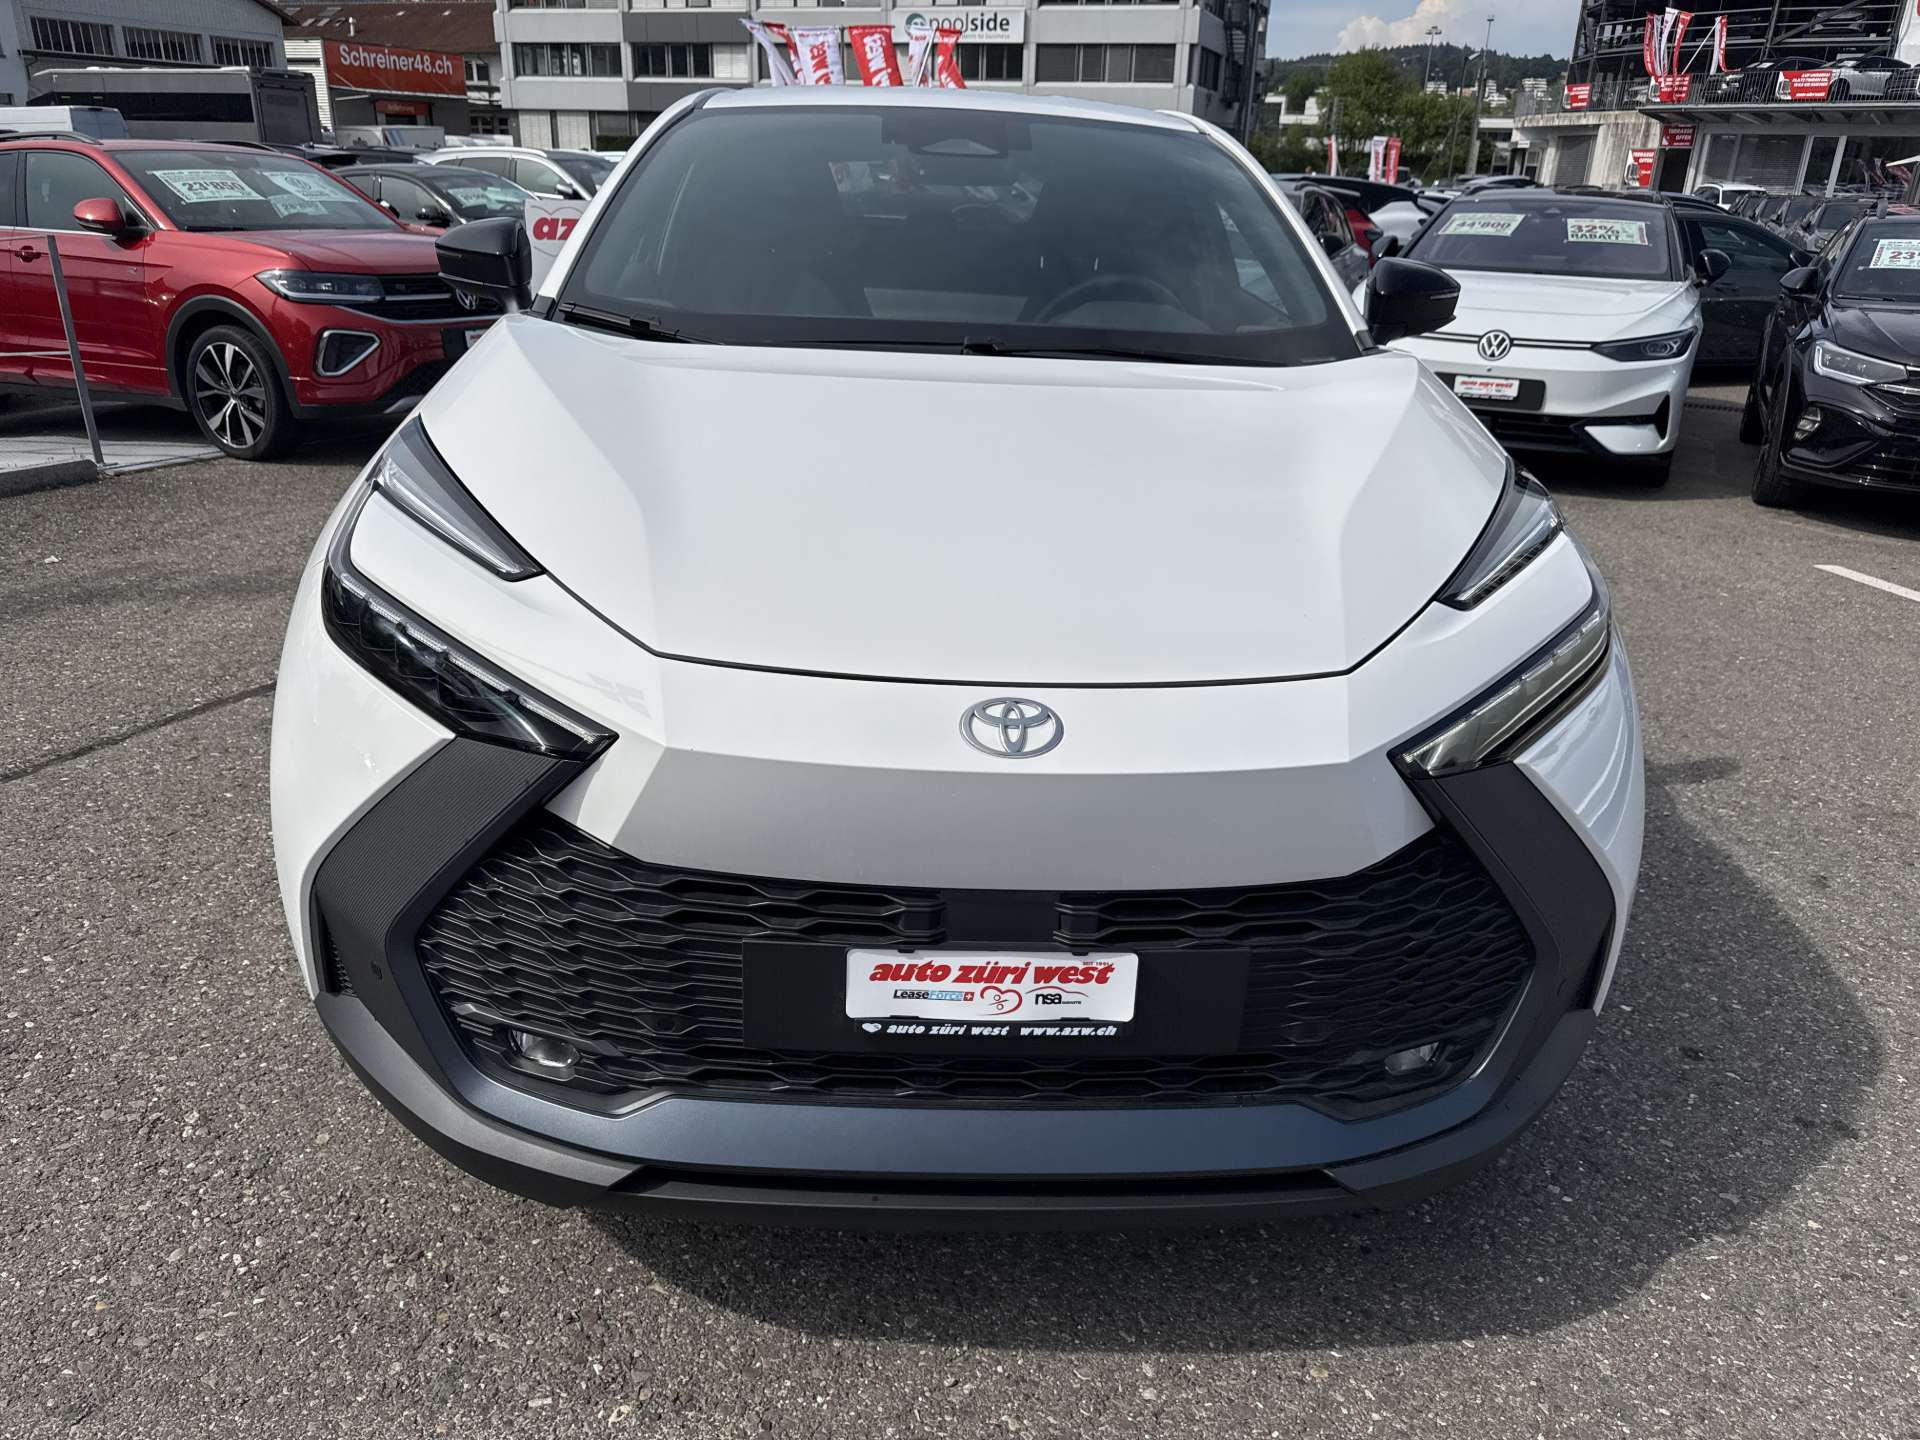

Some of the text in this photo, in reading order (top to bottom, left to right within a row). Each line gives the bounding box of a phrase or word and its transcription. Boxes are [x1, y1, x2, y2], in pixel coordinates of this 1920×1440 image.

[340, 44, 453, 75] Schreiner48.ch
[1570, 224, 1620, 235] 32%
[869, 960, 1116, 985] auto züri west
[893, 989, 963, 1001] LeaseForce
[1035, 993, 1062, 1005] nsa
[887, 1024, 1117, 1036] auto züri west www.azw.ch
